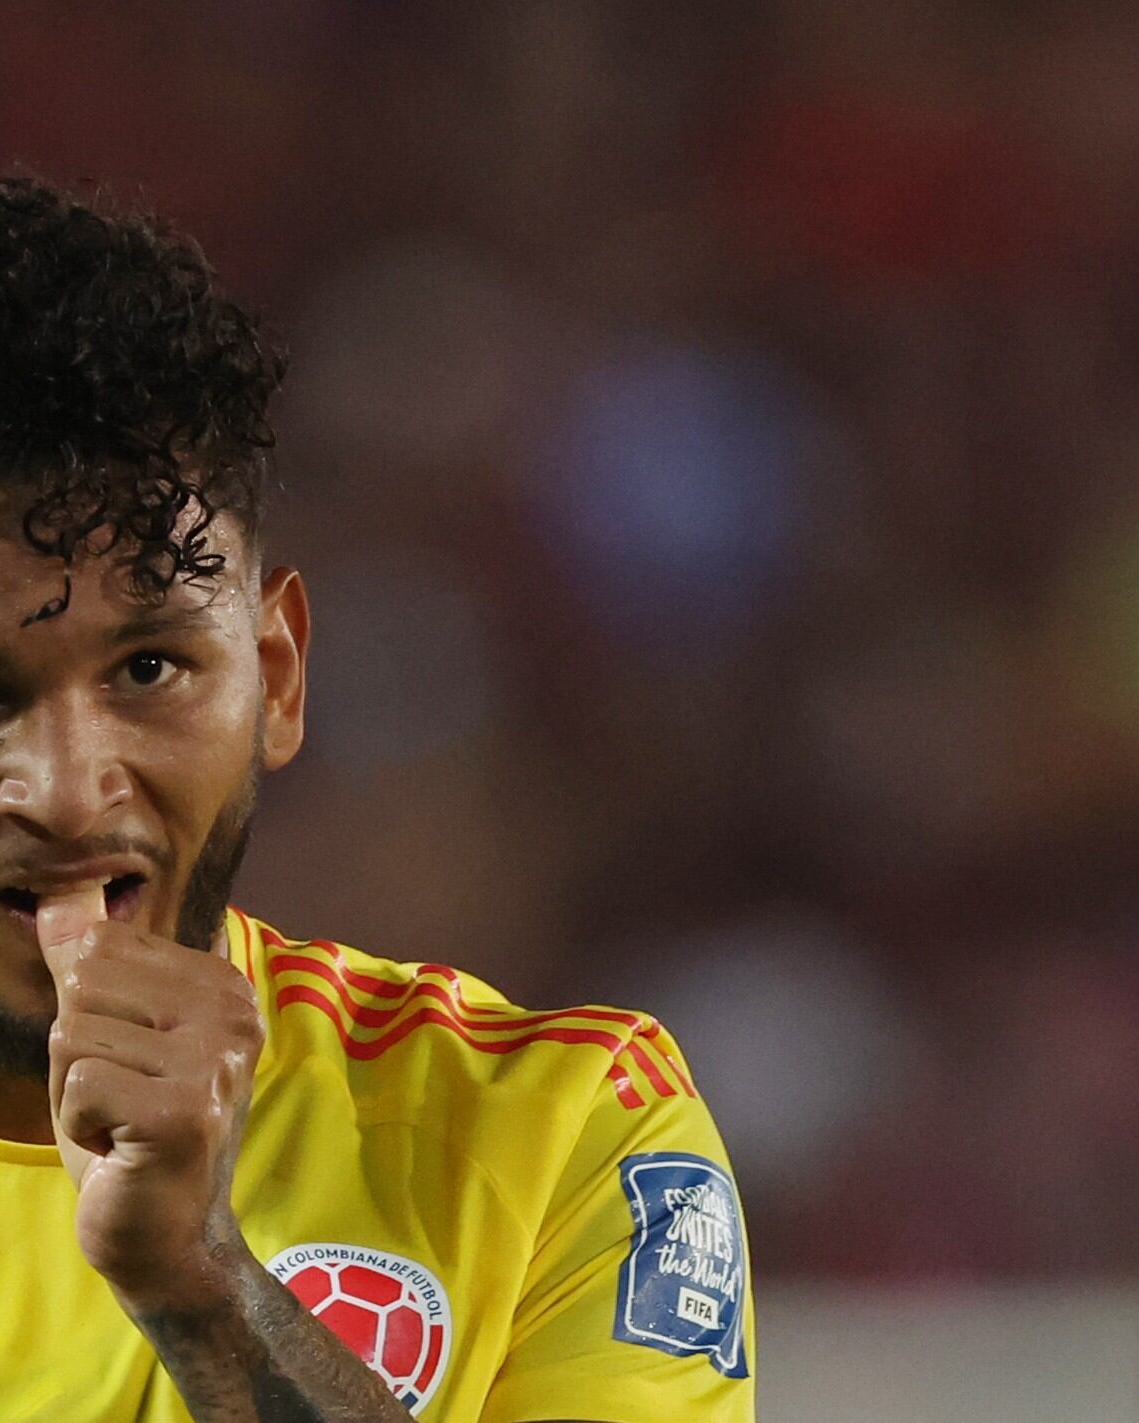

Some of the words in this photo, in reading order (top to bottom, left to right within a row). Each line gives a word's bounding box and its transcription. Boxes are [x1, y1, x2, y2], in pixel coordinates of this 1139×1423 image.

[665, 1208, 733, 1264] UNITES
[287, 1248, 387, 1268] COLOMBIANA
[388, 1261, 410, 1276] DE
[655, 1243, 692, 1276] the
[691, 1253, 736, 1302] World
[685, 1296, 712, 1321] FIFA
